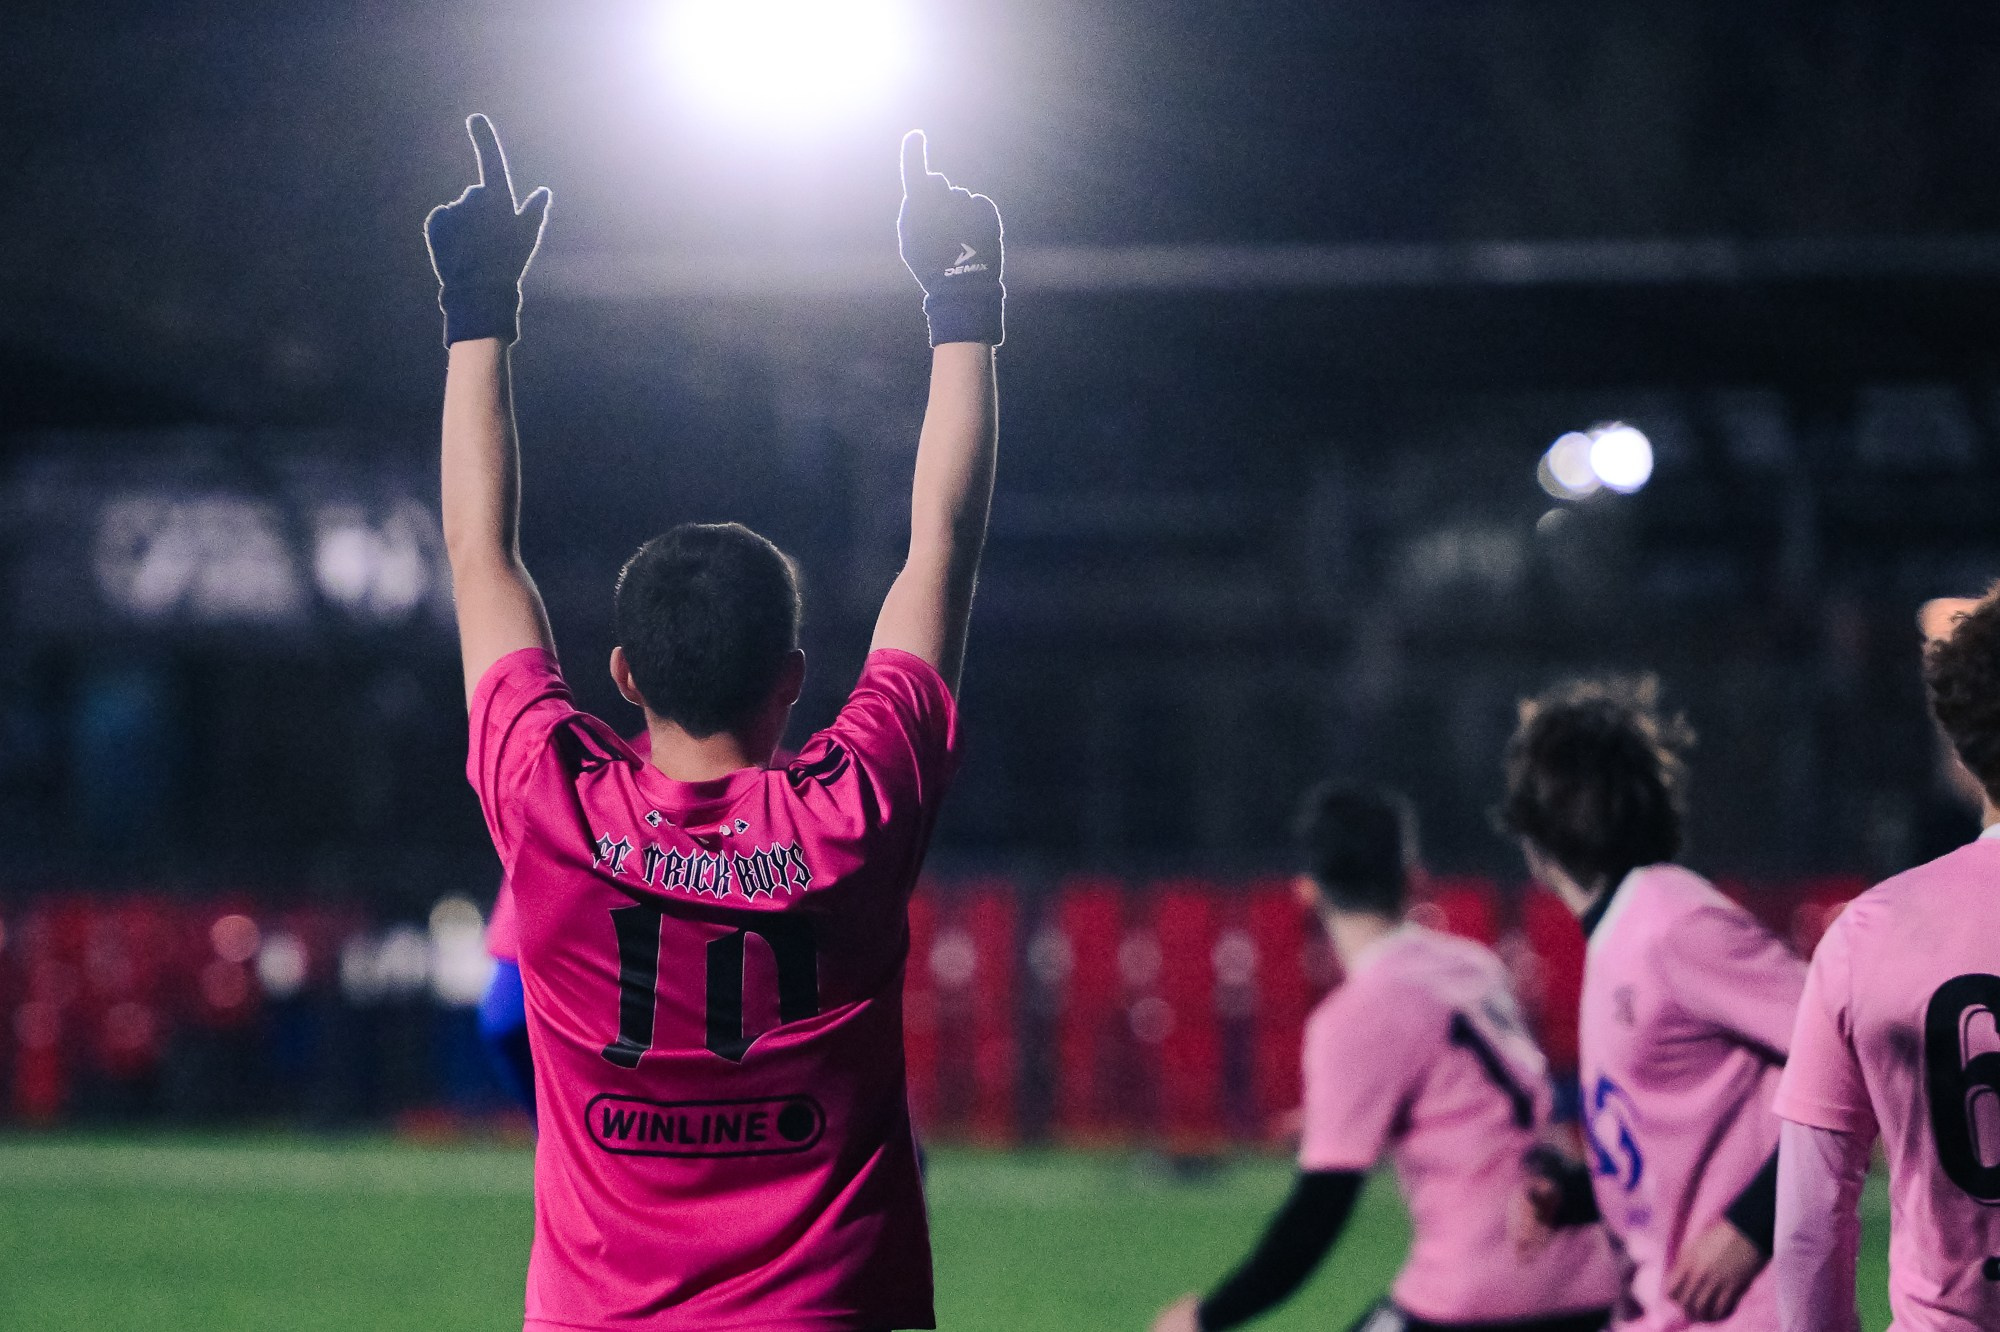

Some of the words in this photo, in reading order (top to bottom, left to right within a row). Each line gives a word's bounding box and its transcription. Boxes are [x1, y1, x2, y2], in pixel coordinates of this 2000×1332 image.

[591, 832, 634, 877] FC
[1924, 972, 2000, 1207] 6
[603, 1107, 769, 1145] WINLINE
